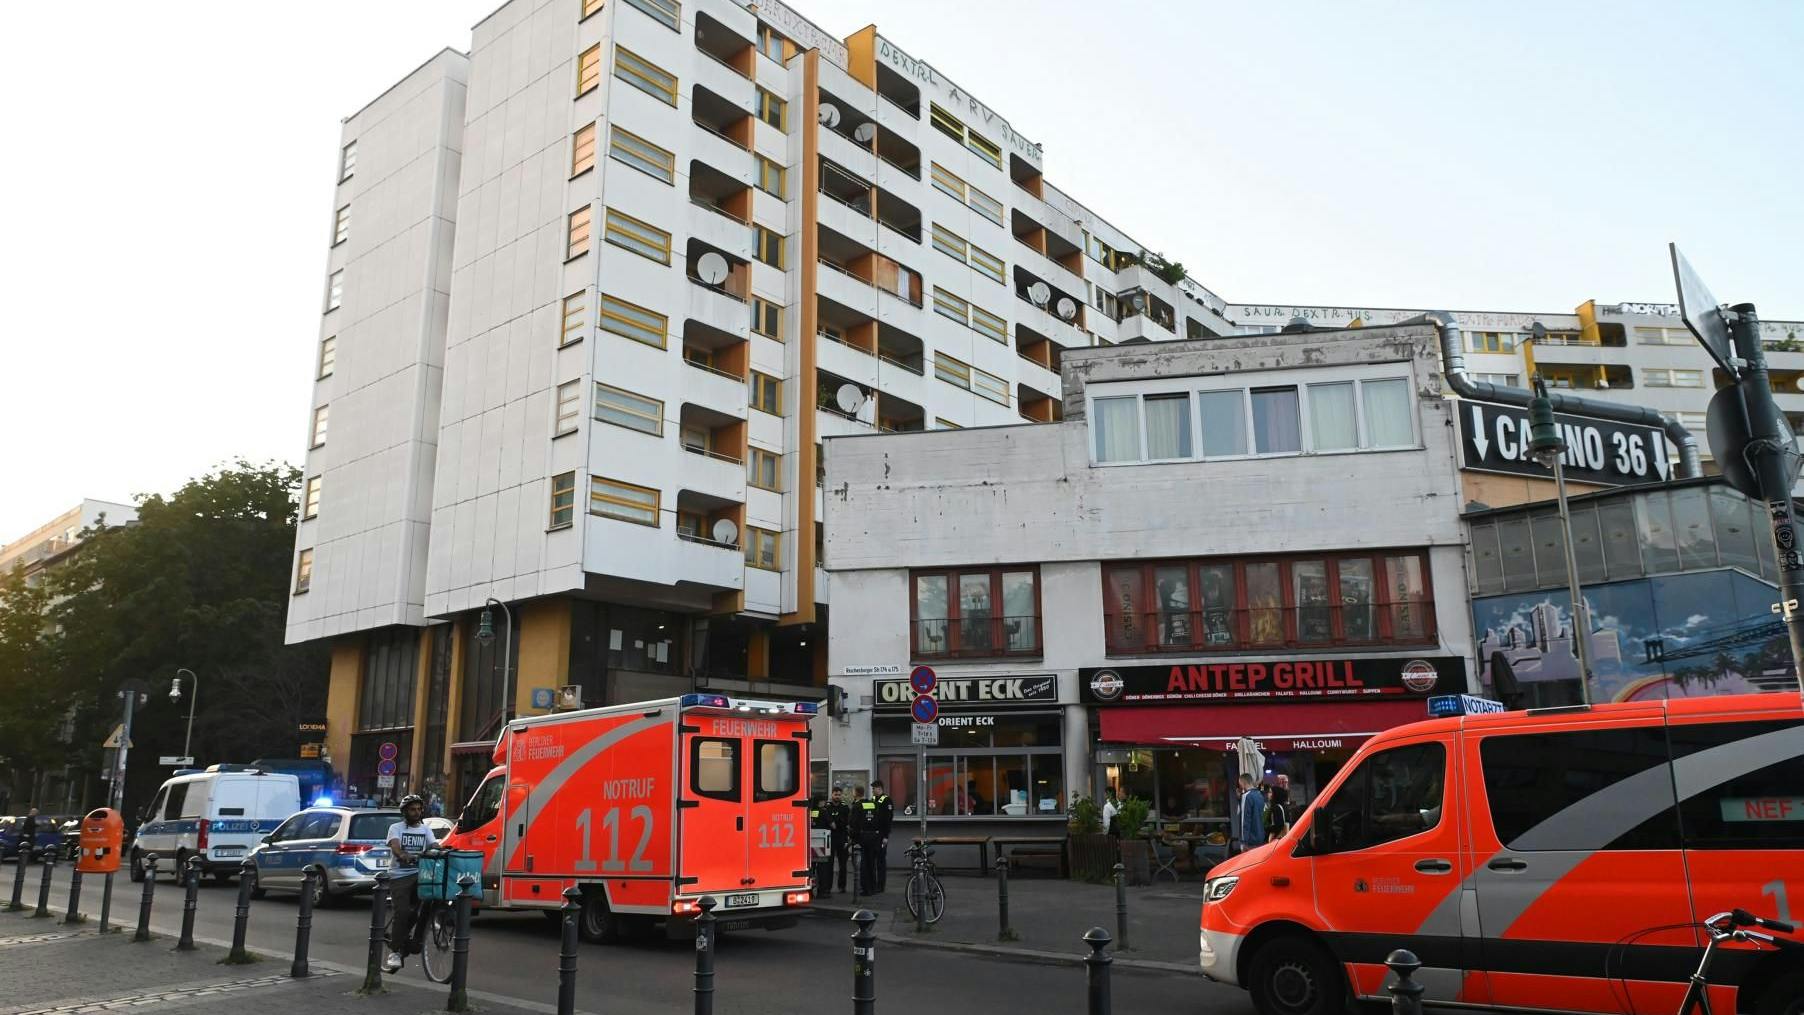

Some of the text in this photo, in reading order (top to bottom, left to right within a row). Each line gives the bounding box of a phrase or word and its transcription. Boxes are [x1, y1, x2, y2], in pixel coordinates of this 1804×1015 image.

[1496, 414, 1648, 476] CAINO 36
[1167, 660, 1364, 692] ANTEP GRILL
[881, 678, 1025, 701] ORENT ECK
[712, 719, 777, 737] FEUERWEHR
[939, 716, 995, 727] ORIENT ECK
[528, 745, 565, 760] FEUERWEHR
[1292, 739, 1342, 750] HALLOUMI
[603, 777, 656, 801] NOTRUF
[1744, 799, 1793, 819] NEF
[212, 822, 249, 831] POLIZEI
[758, 823, 795, 848] 112
[575, 804, 654, 872] 112
